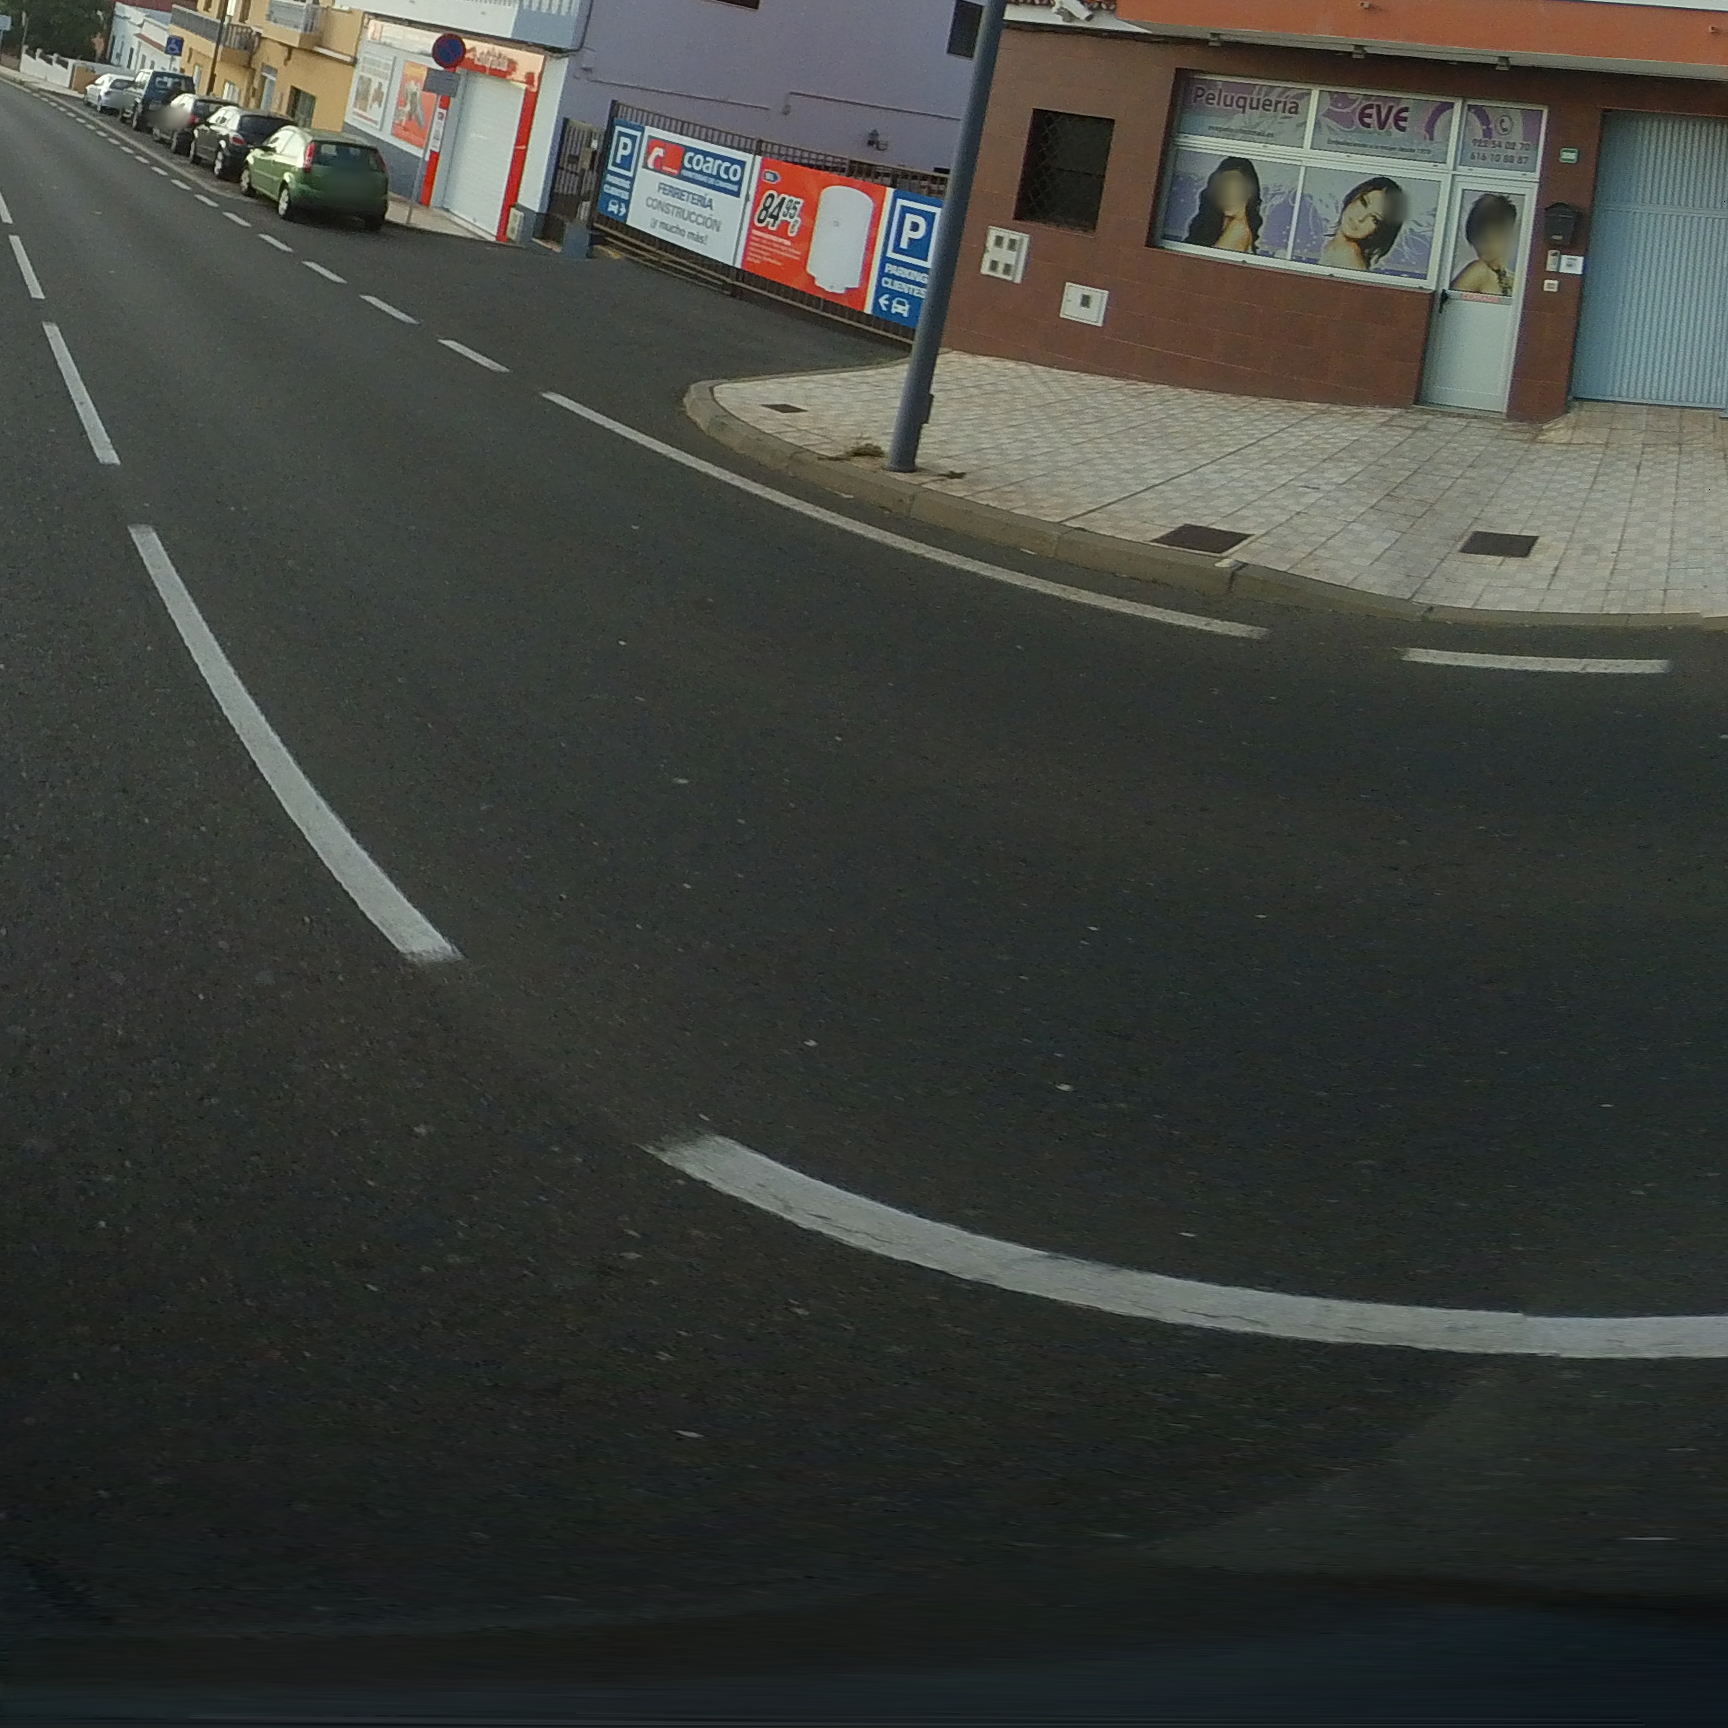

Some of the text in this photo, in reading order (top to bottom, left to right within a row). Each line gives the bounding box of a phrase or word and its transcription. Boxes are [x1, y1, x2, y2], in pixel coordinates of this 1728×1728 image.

[1193, 87, 1300, 116] Peluquería
[615, 136, 633, 164] P
[1470, 152, 1487, 161] 616
[683, 151, 742, 181] coarco
[657, 182, 714, 210] FERRETERÍA
[645, 196, 722, 233] CONSTRUCCIÓN
[899, 213, 927, 249] P
[881, 277, 927, 298] CLIENTES
[884, 263, 929, 284] PARKING
